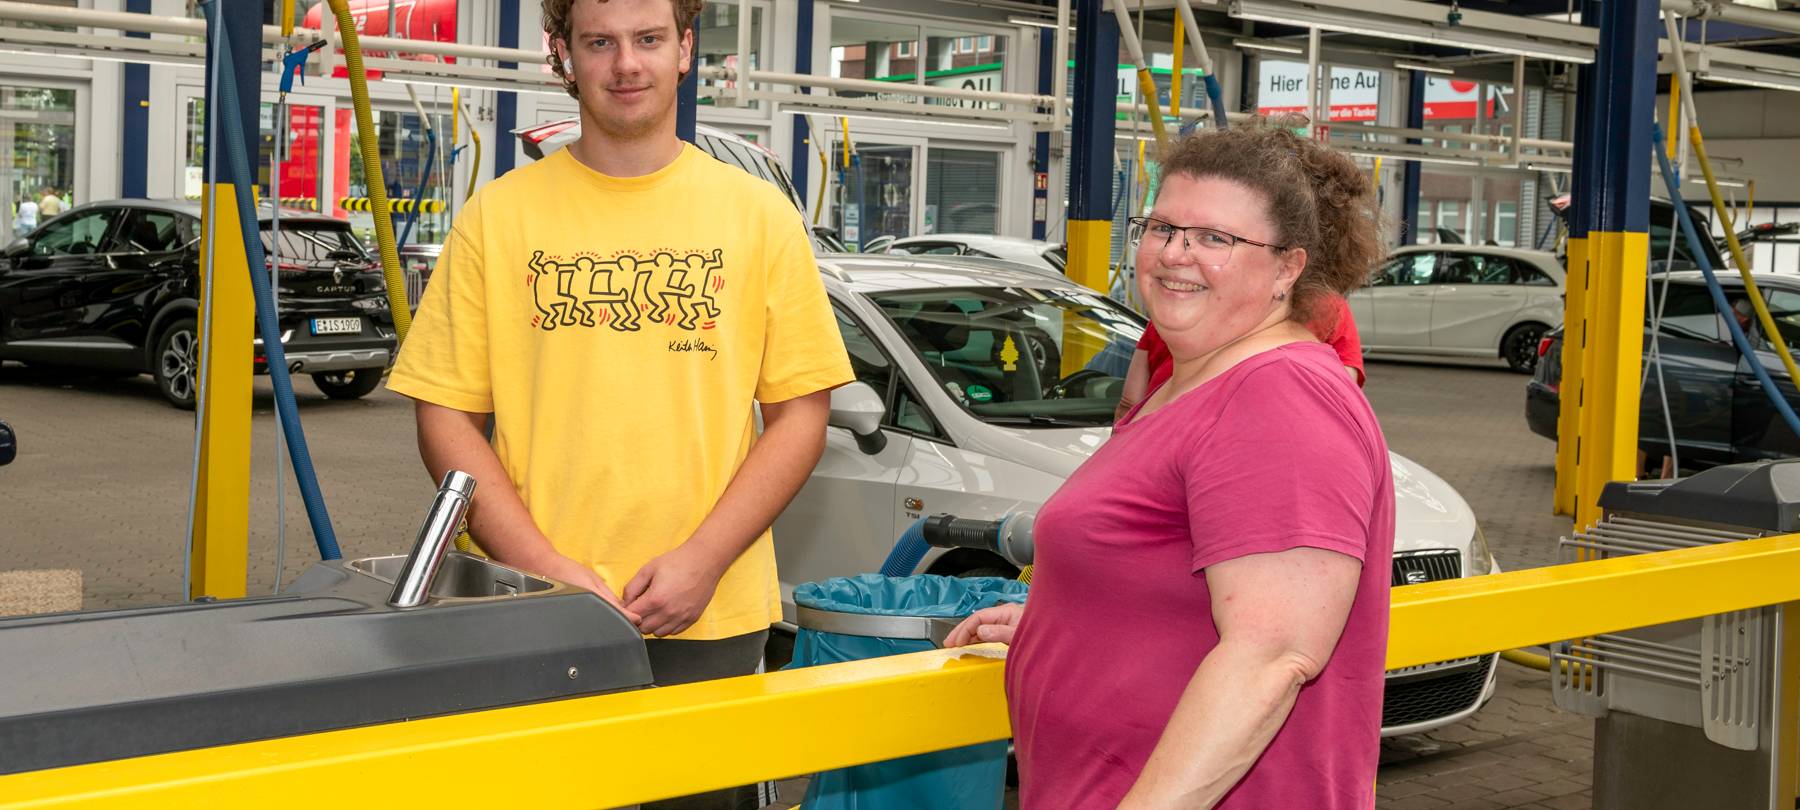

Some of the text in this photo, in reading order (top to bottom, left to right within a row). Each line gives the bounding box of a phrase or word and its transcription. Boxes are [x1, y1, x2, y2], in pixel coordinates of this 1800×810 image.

[1270, 75, 1302, 92] Hier
[316, 285, 357, 293] CAPTUR
[668, 339, 693, 352] Keith
